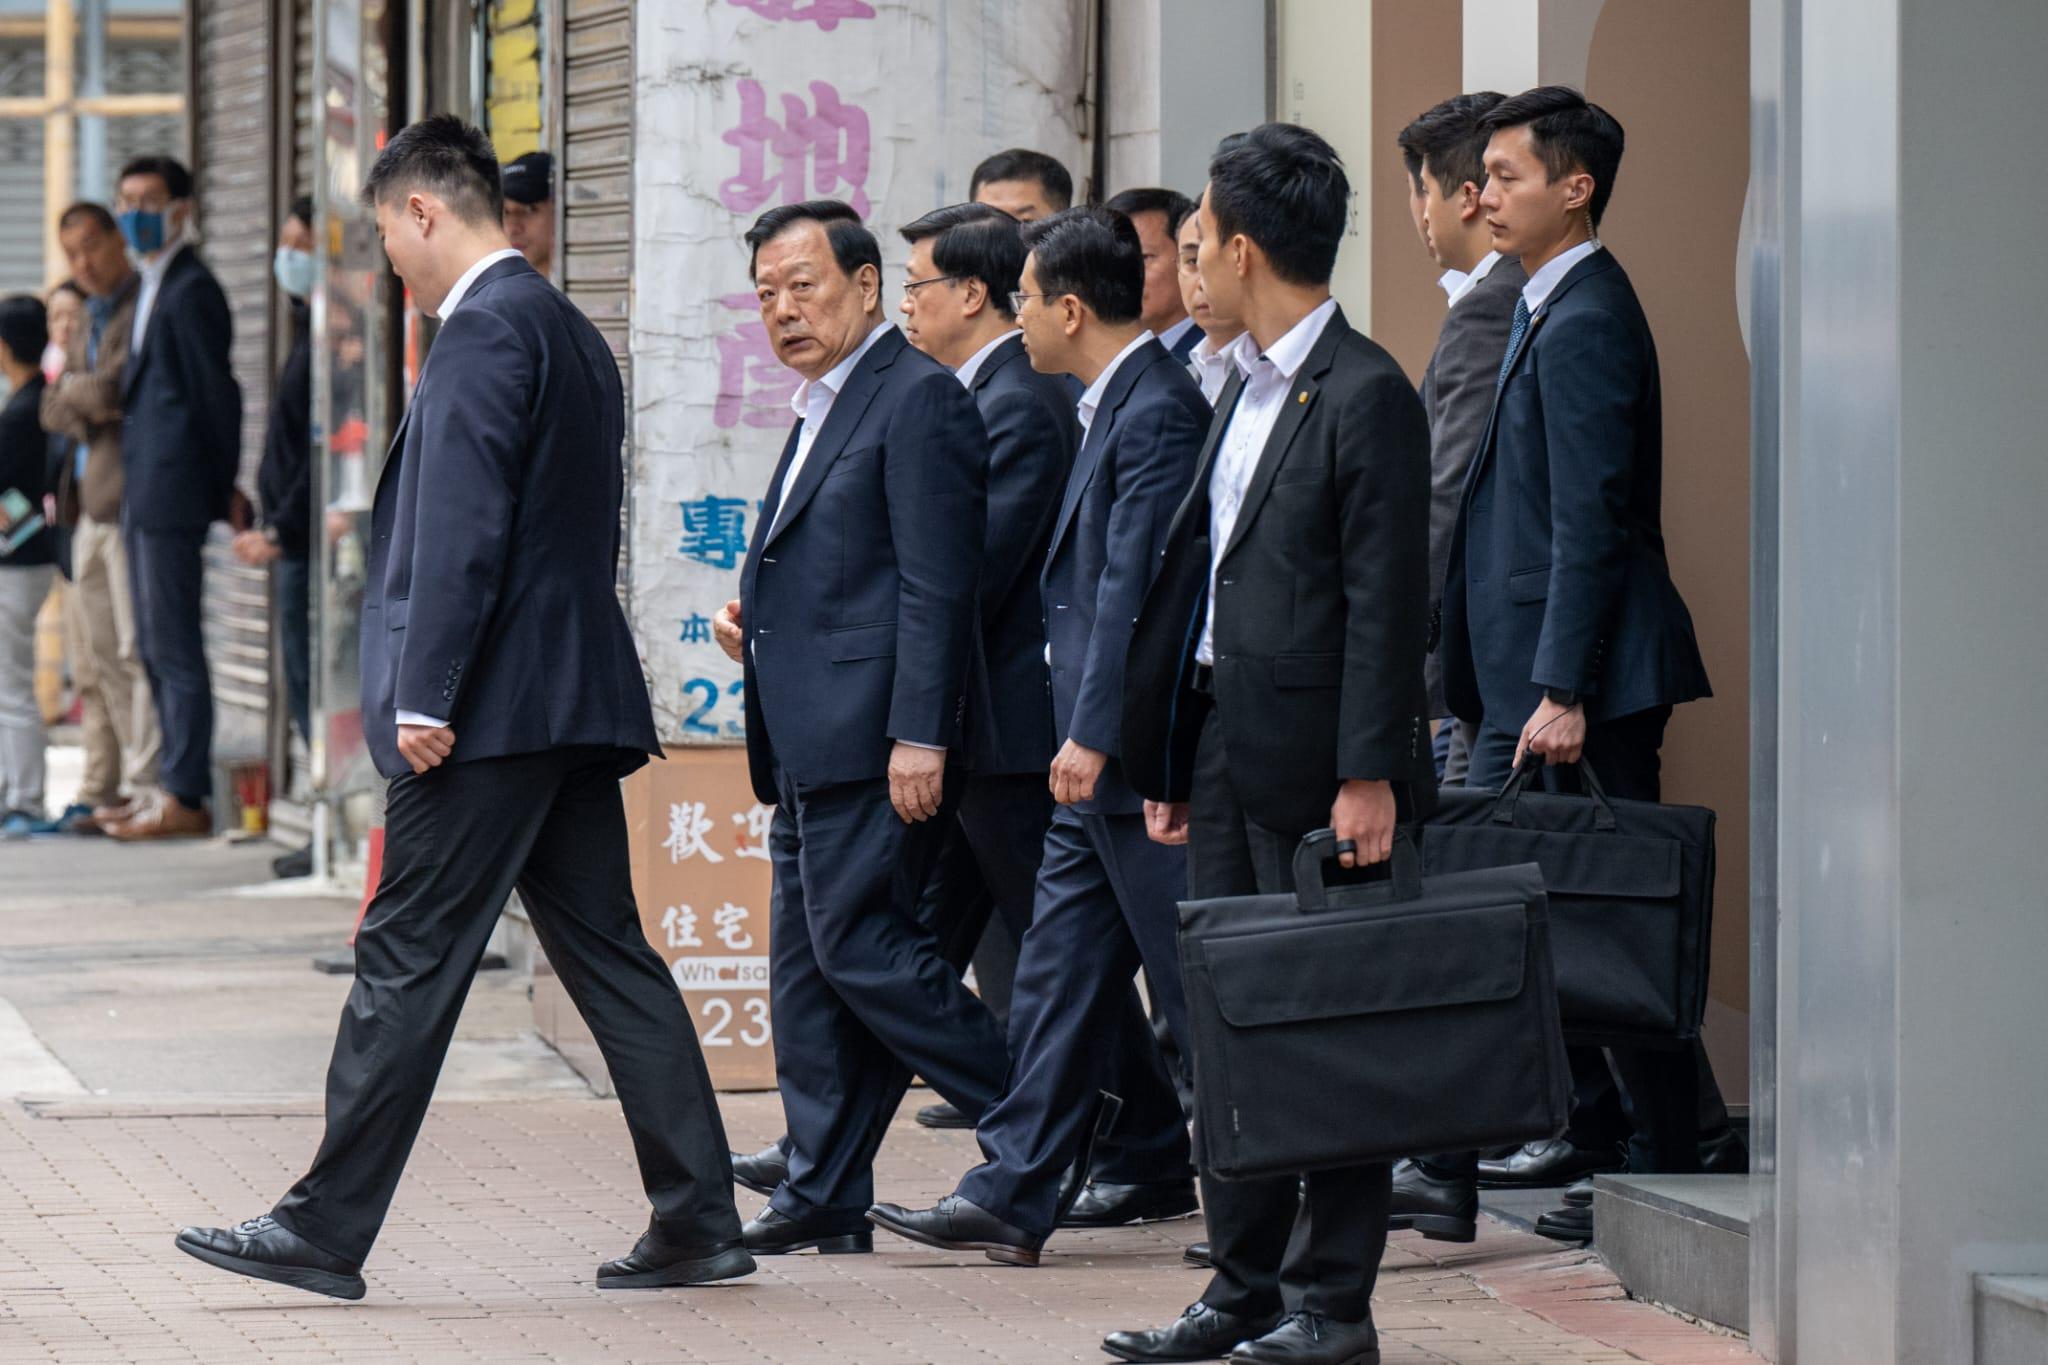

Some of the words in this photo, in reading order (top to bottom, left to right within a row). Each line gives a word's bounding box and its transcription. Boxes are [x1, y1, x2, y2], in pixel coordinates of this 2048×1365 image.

[678, 494, 764, 570] 專
[660, 902, 753, 950] 住宅
[701, 997, 771, 1047] 23
